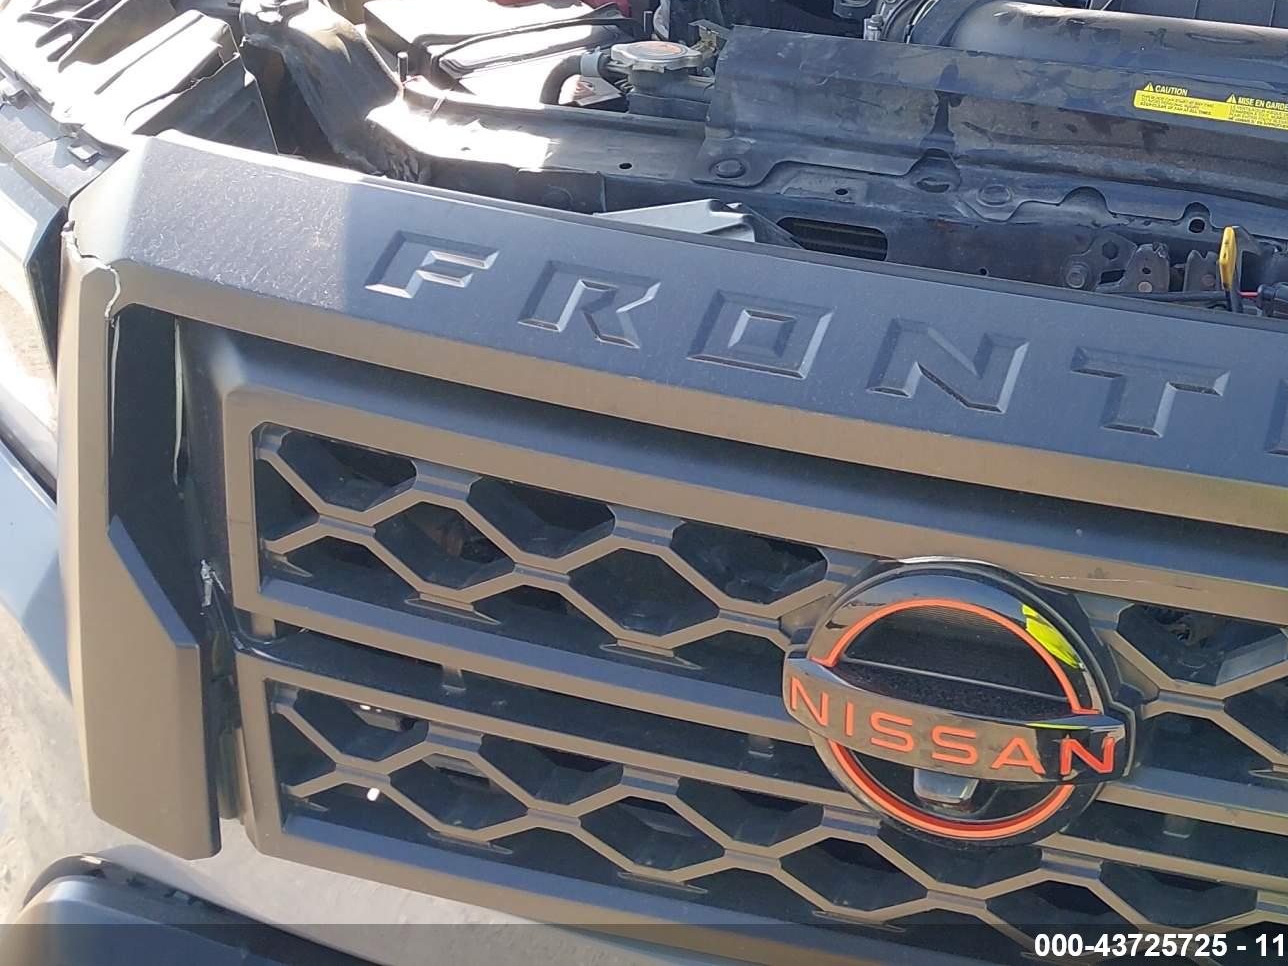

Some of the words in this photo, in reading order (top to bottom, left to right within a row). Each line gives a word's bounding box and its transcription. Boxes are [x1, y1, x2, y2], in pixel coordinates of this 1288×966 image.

[1155, 85, 1188, 96] CAUTION
[1237, 97, 1255, 106] MISE
[1255, 99, 1265, 108] EN
[788, 677, 1116, 776] NISSAN
